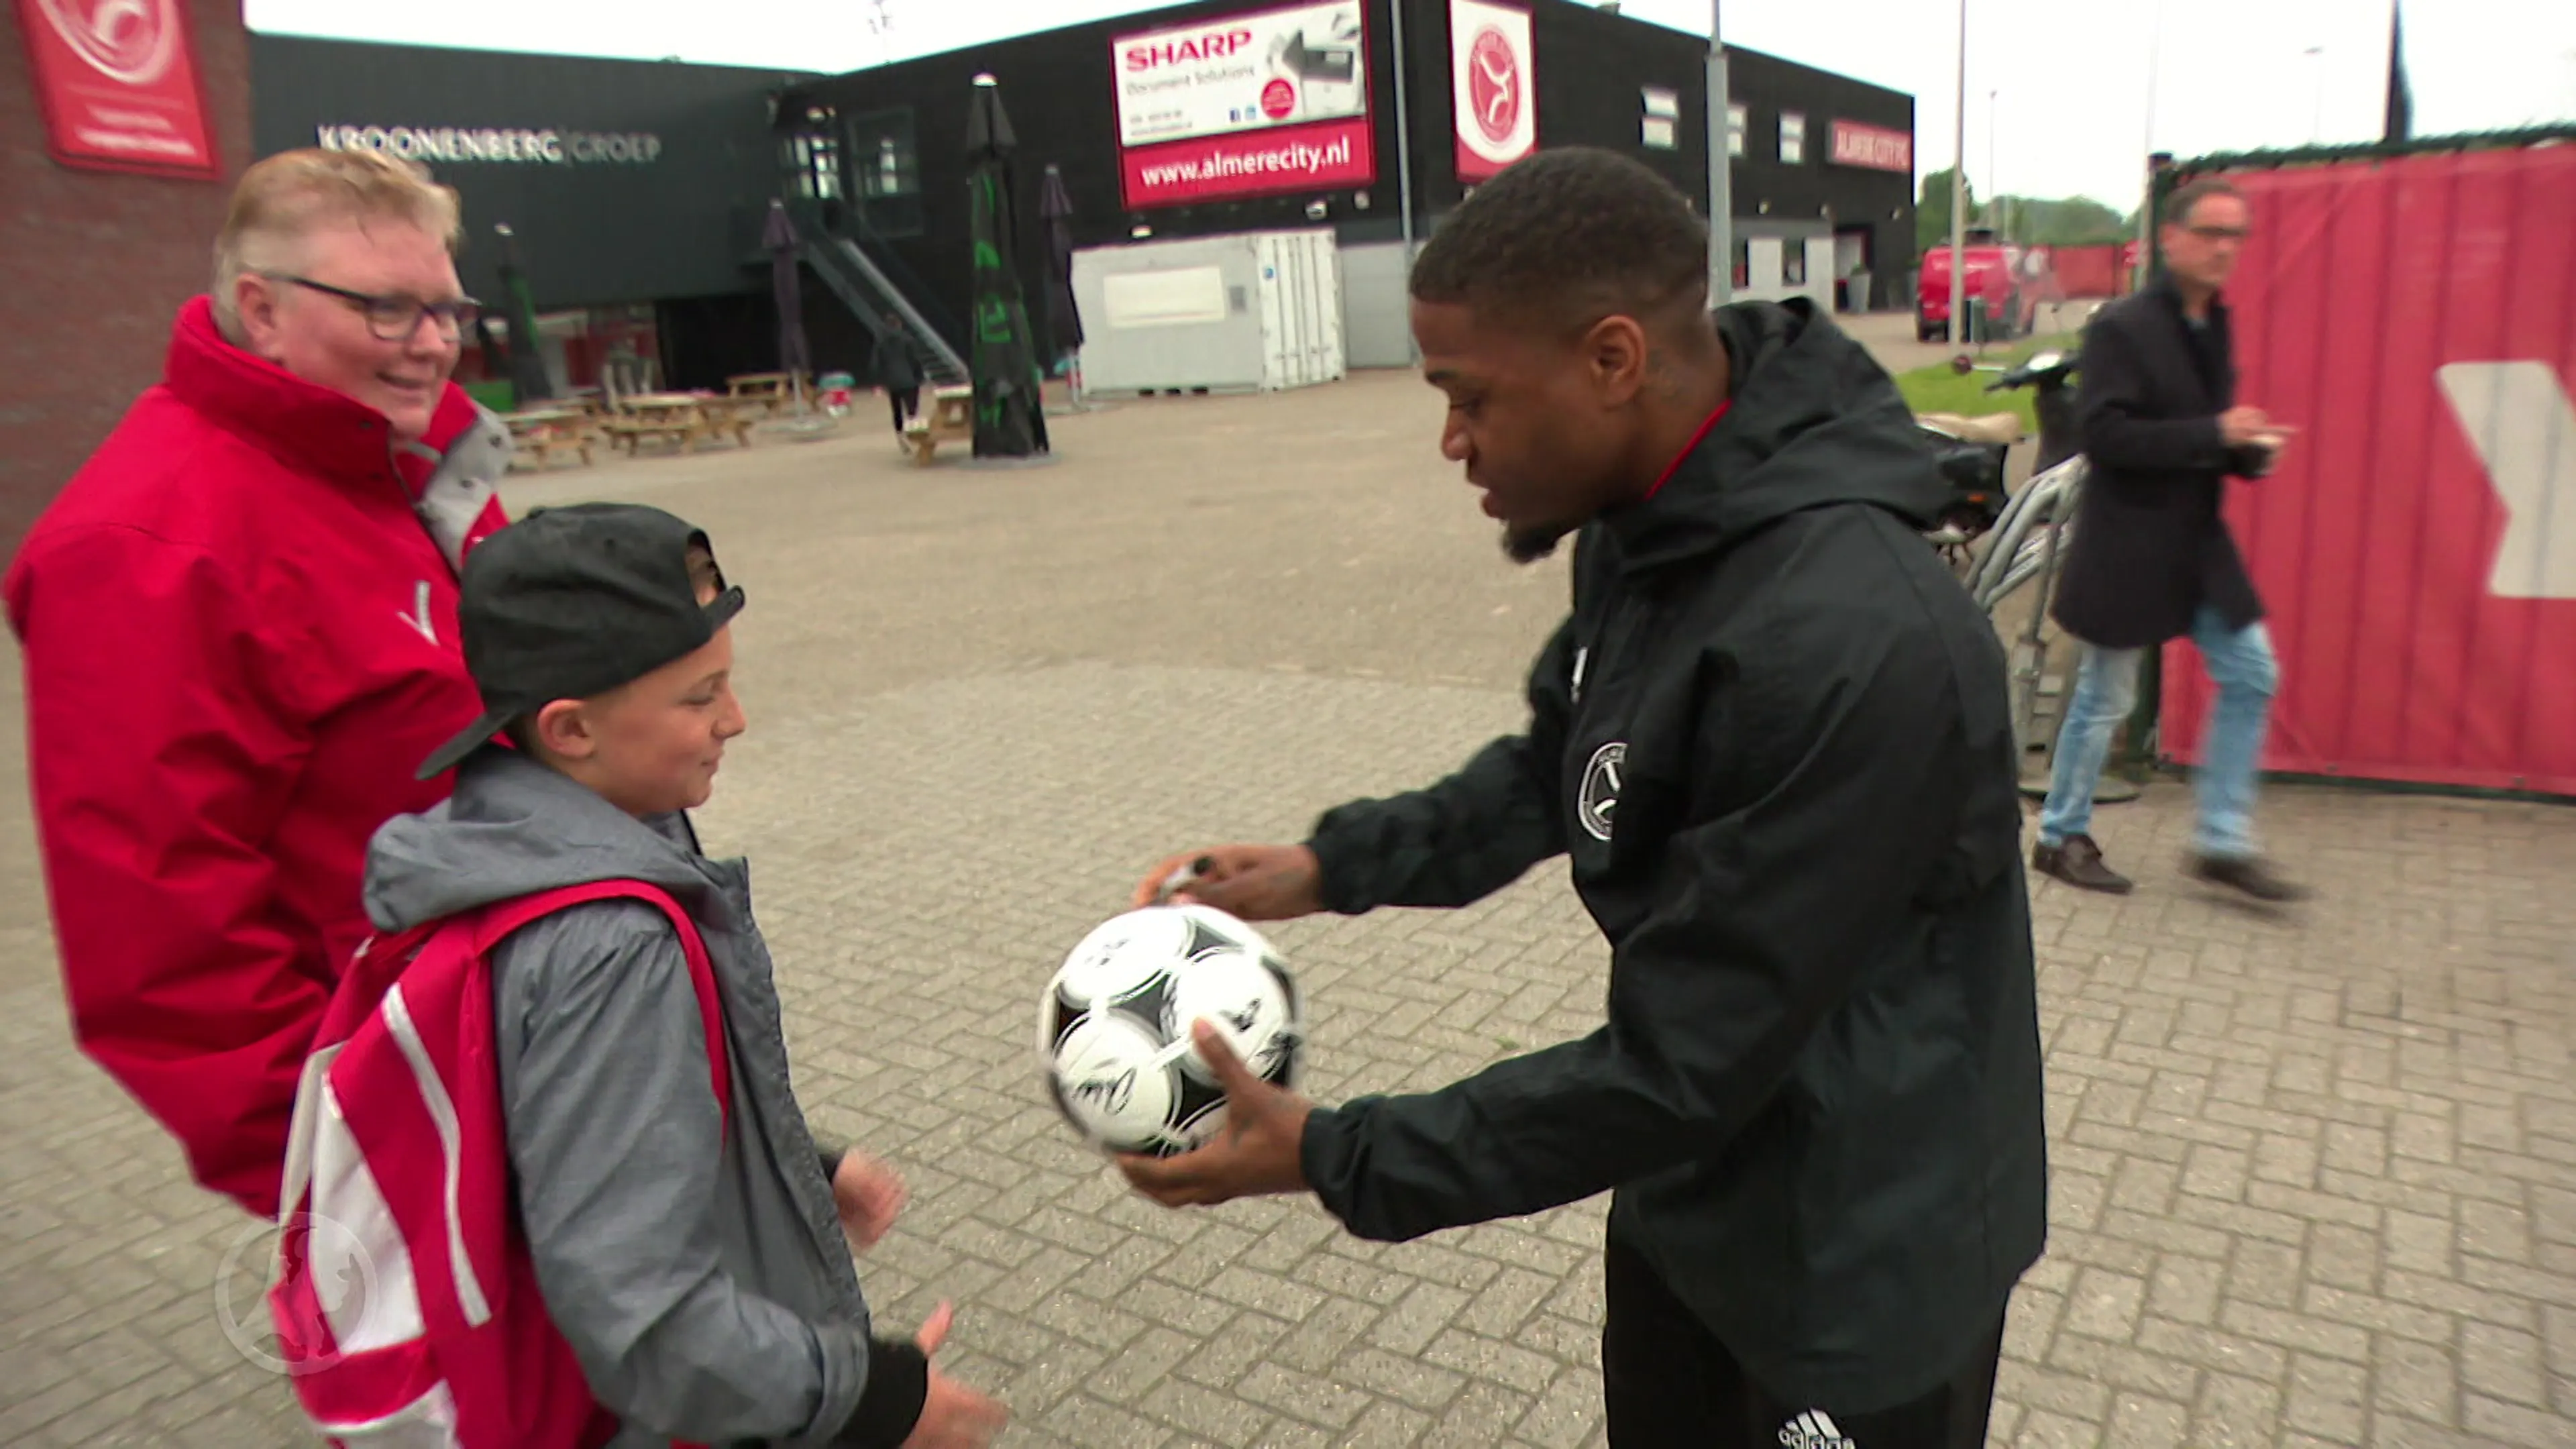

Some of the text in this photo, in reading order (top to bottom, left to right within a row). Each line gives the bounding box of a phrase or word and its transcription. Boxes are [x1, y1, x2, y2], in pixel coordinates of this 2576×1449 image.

[1126, 28, 1252, 72] SHARP
[1126, 75, 1191, 95] Document
[317, 124, 661, 164] KROONENBERG GROEP
[1140, 136, 1351, 187] www.almerecity.nl
